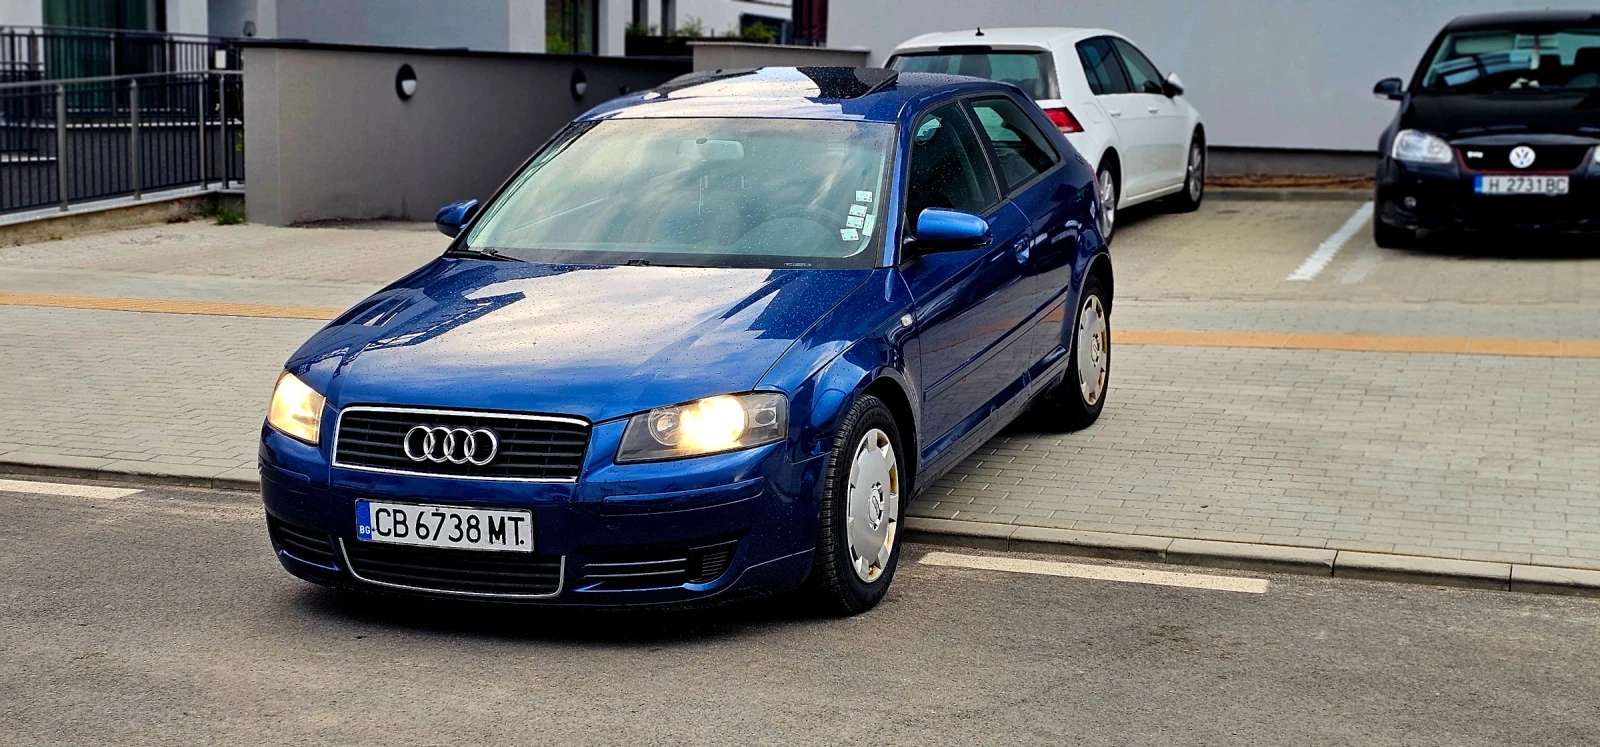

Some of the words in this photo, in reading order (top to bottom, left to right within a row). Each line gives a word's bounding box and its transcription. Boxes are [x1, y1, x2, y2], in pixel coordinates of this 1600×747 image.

[1489, 179, 1499, 192] H
[359, 526, 371, 534] BG
[375, 508, 409, 538] CB
[415, 511, 481, 544] 6738
